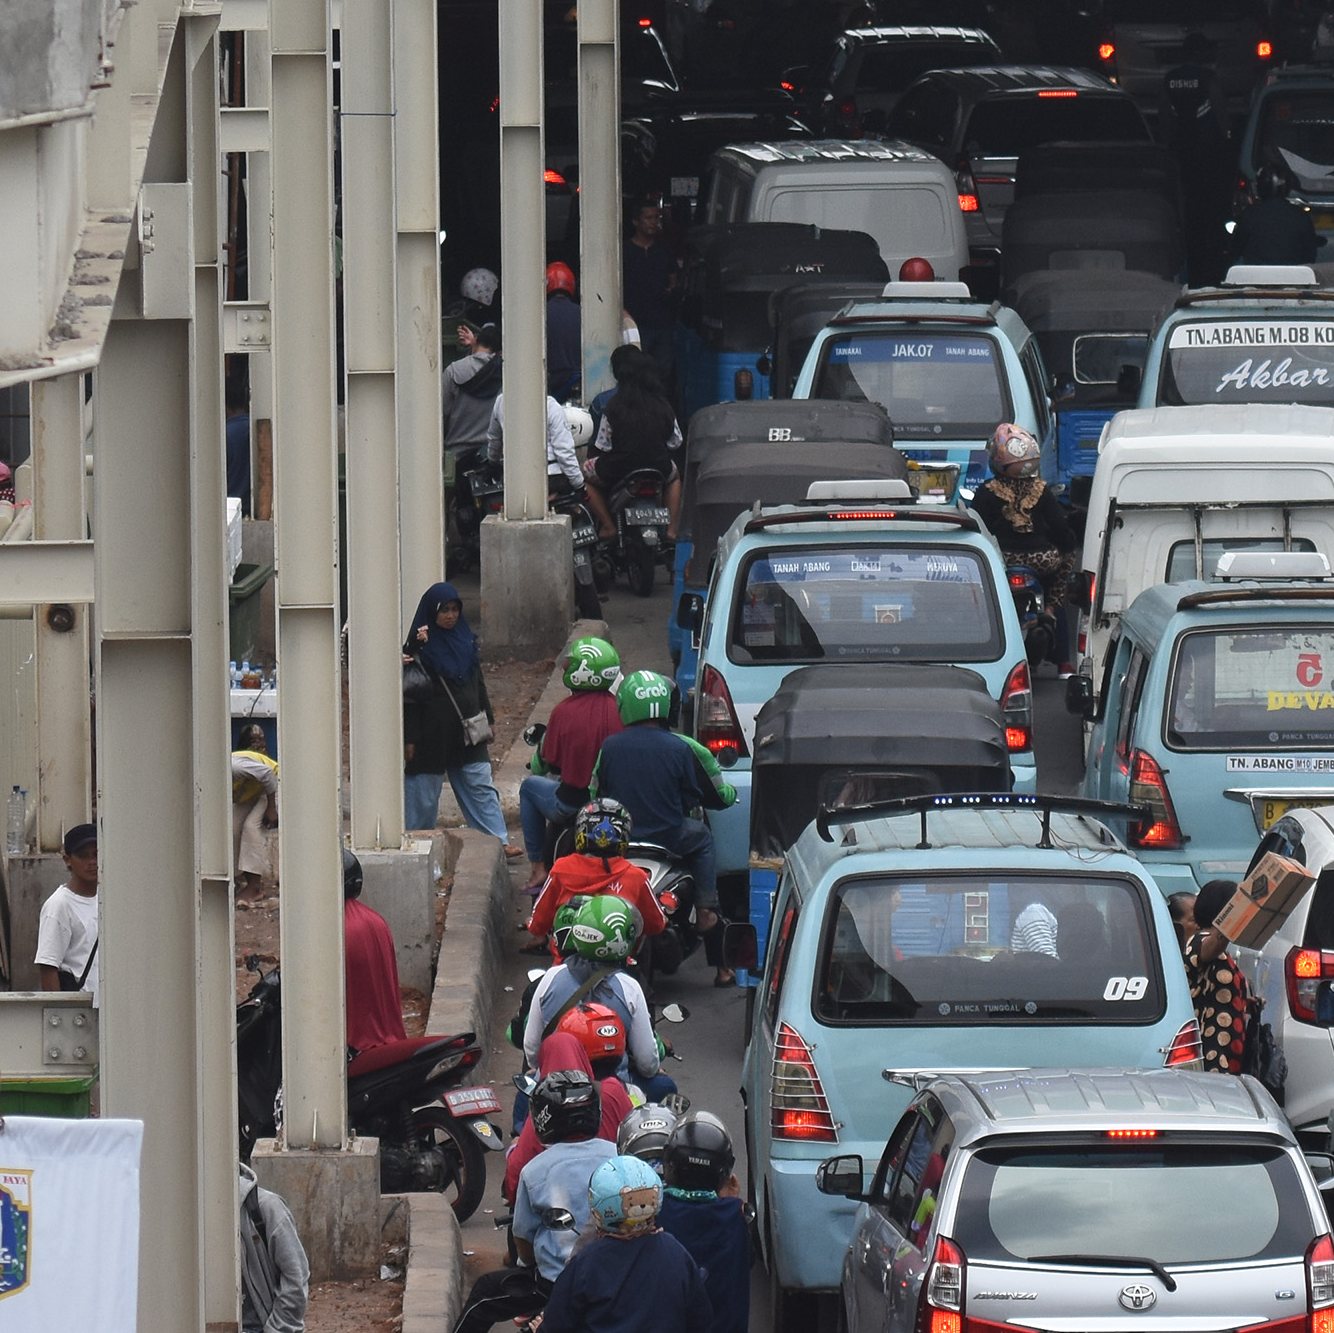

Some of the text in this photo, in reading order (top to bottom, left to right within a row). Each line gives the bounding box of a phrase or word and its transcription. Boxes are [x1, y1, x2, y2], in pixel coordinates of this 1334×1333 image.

[1269, 327, 1310, 344] M.08
[892, 344, 934, 357] JAK.07
[945, 347, 966, 356] TANAH
[968, 348, 990, 356] ABANG
[1216, 357, 1330, 393] Akbar
[774, 564, 799, 573] TANAH
[803, 562, 831, 572] ABANG
[634, 683, 668, 700] Grab
[1229, 758, 1250, 769] TN.
[1252, 758, 1294, 770] ABANG
[1265, 803, 1275, 820] B
[1103, 976, 1149, 1002] 09
[954, 1003, 1021, 1013] PANCA TUNGGAL
[973, 1290, 1040, 1300] AVANZA
